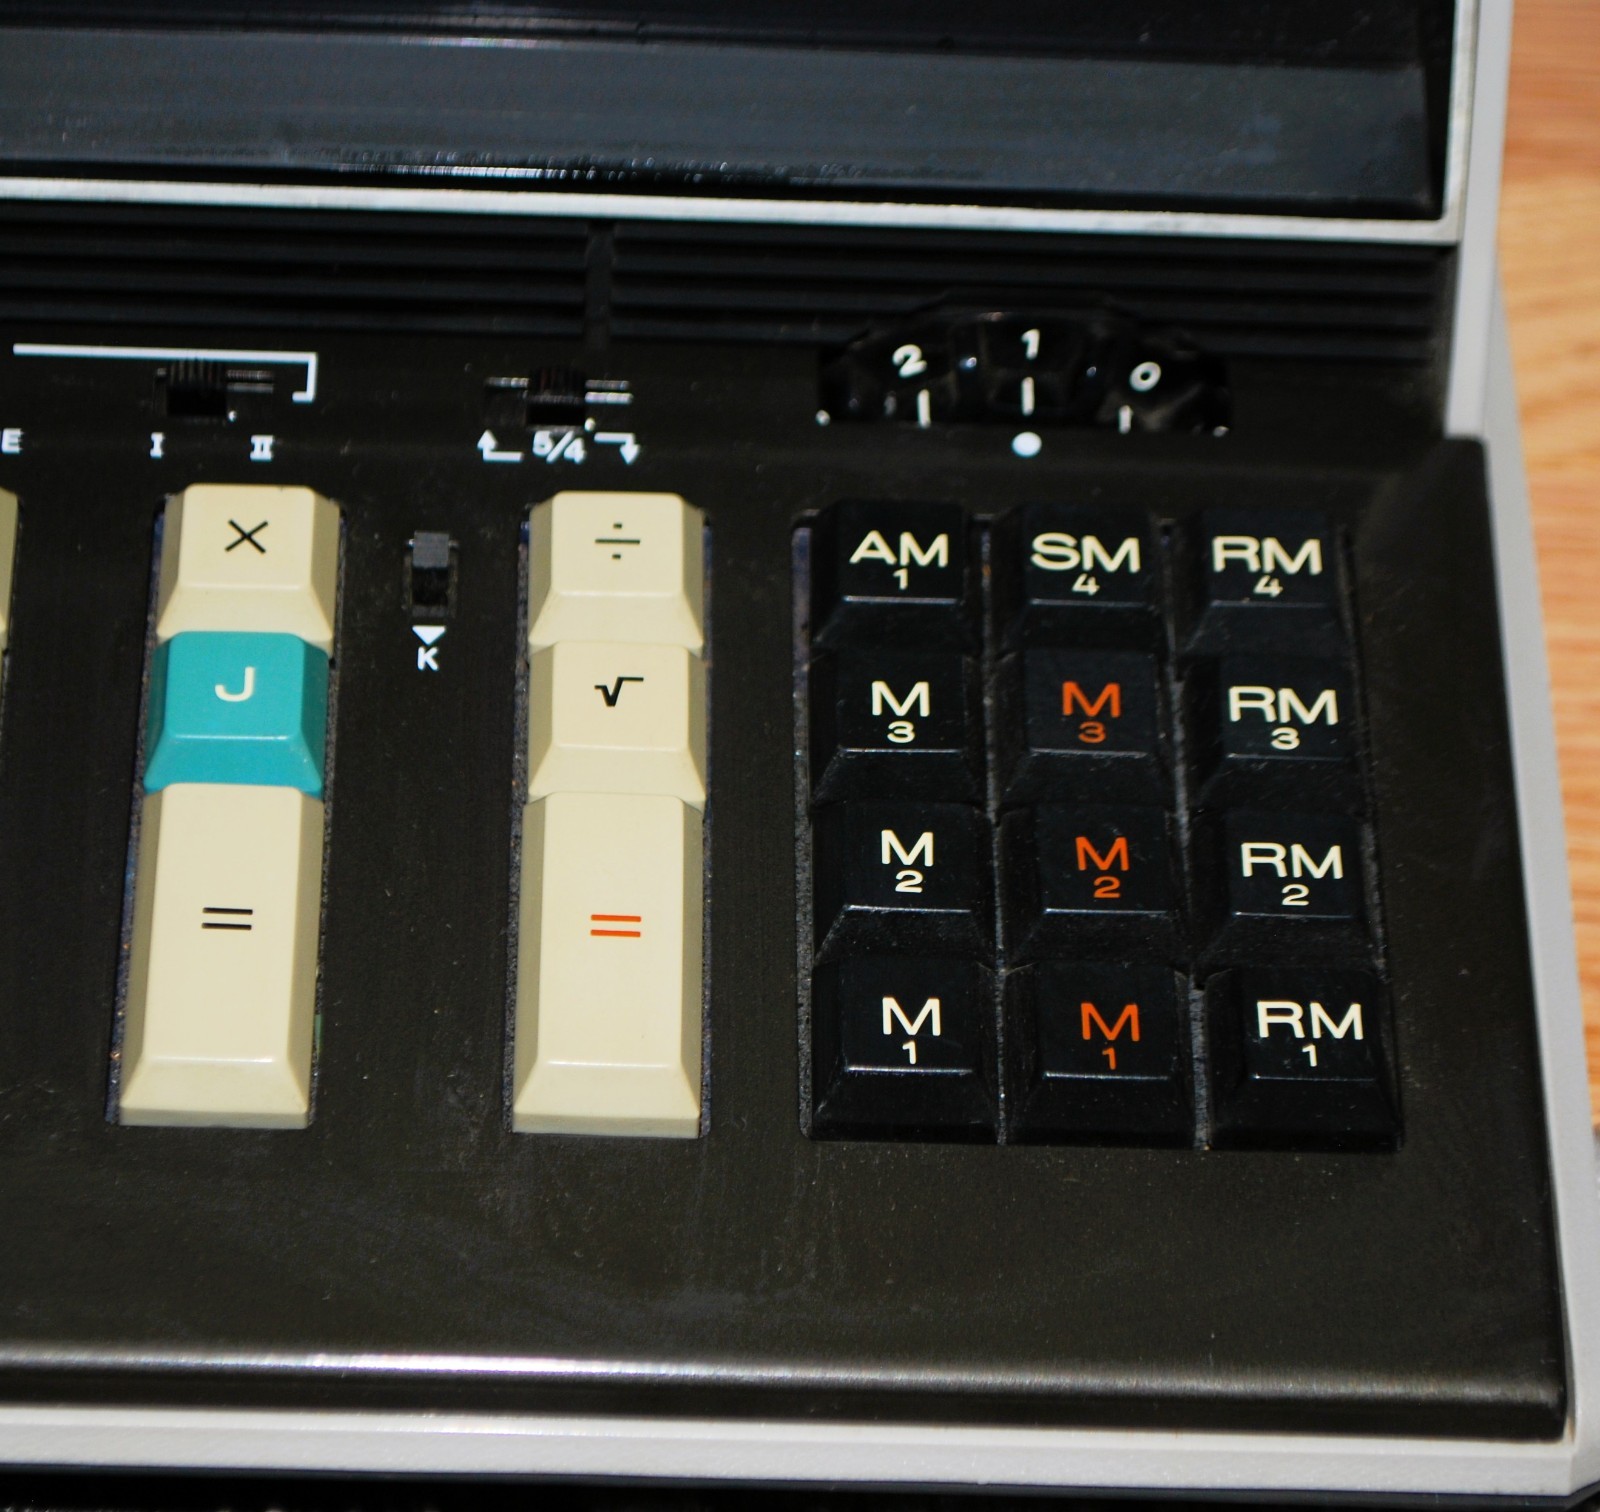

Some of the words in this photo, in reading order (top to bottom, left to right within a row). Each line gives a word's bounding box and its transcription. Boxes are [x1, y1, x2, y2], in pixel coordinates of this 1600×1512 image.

[1022, 329, 1040, 358] 1
[892, 344, 927, 377] 2
[532, 431, 587, 464] 5/4
[849, 530, 949, 569] AM
[1030, 532, 1141, 574] SM
[1212, 535, 1323, 575] RM
[893, 568, 908, 590] 1
[1072, 573, 1100, 596] 4
[1253, 575, 1283, 597] 4
[417, 646, 439, 671] K
[214, 666, 256, 702] J
[871, 680, 930, 718] M
[1062, 681, 1121, 718] M
[1228, 685, 1339, 726] RM
[886, 720, 916, 744] 3
[1079, 721, 1106, 743] 3
[1270, 726, 1300, 751] 3
[881, 829, 934, 867] M
[1075, 836, 1130, 871] M
[1240, 842, 1344, 880] RM
[894, 869, 924, 894] 2
[1093, 875, 1121, 899] 2
[1281, 883, 1310, 906] 2
[881, 996, 941, 1037] M
[1080, 1002, 1140, 1042] M
[1256, 1000, 1364, 1041] RM
[901, 1040, 917, 1065] 1
[1102, 1047, 1117, 1070] 1
[1301, 1043, 1318, 1067] 1
